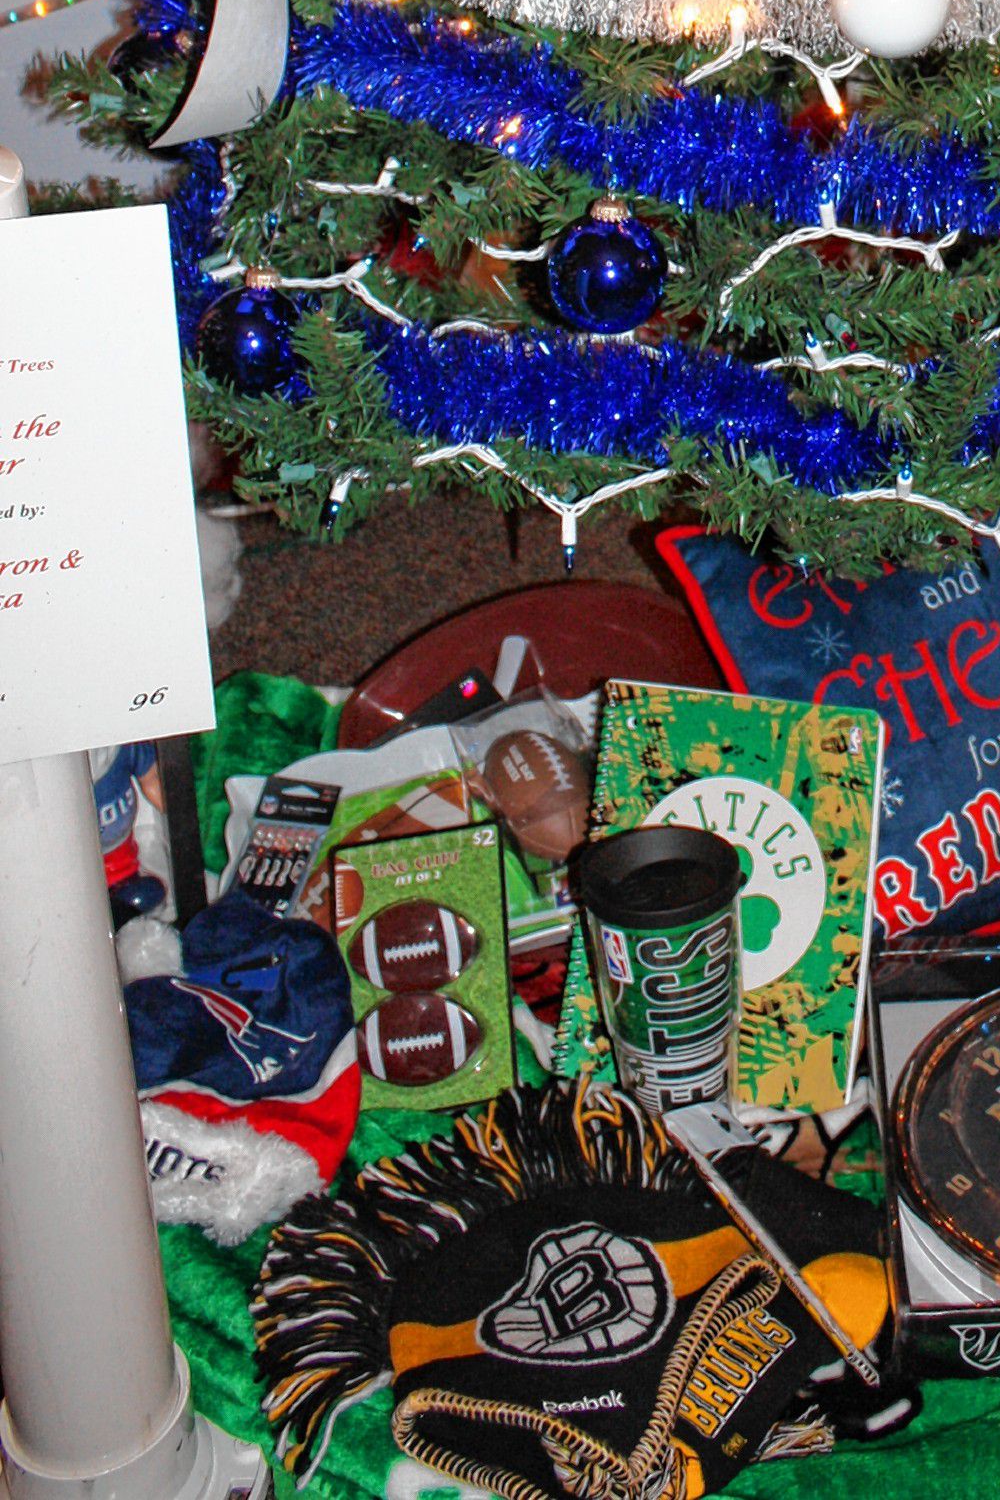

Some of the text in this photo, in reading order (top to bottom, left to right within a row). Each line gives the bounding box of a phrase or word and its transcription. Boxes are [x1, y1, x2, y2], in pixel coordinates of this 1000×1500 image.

[8, 359, 54, 374] Trees
[12, 413, 61, 440] the
[20, 504, 46, 520] by:
[60, 549, 84, 570] &
[920, 564, 982, 611] and
[128, 686, 169, 712] 96
[472, 828, 496, 847] $2
[945, 1172, 974, 1198] 10
[676, 1306, 798, 1438] BRUINS
[541, 1388, 626, 1415] Reebok
